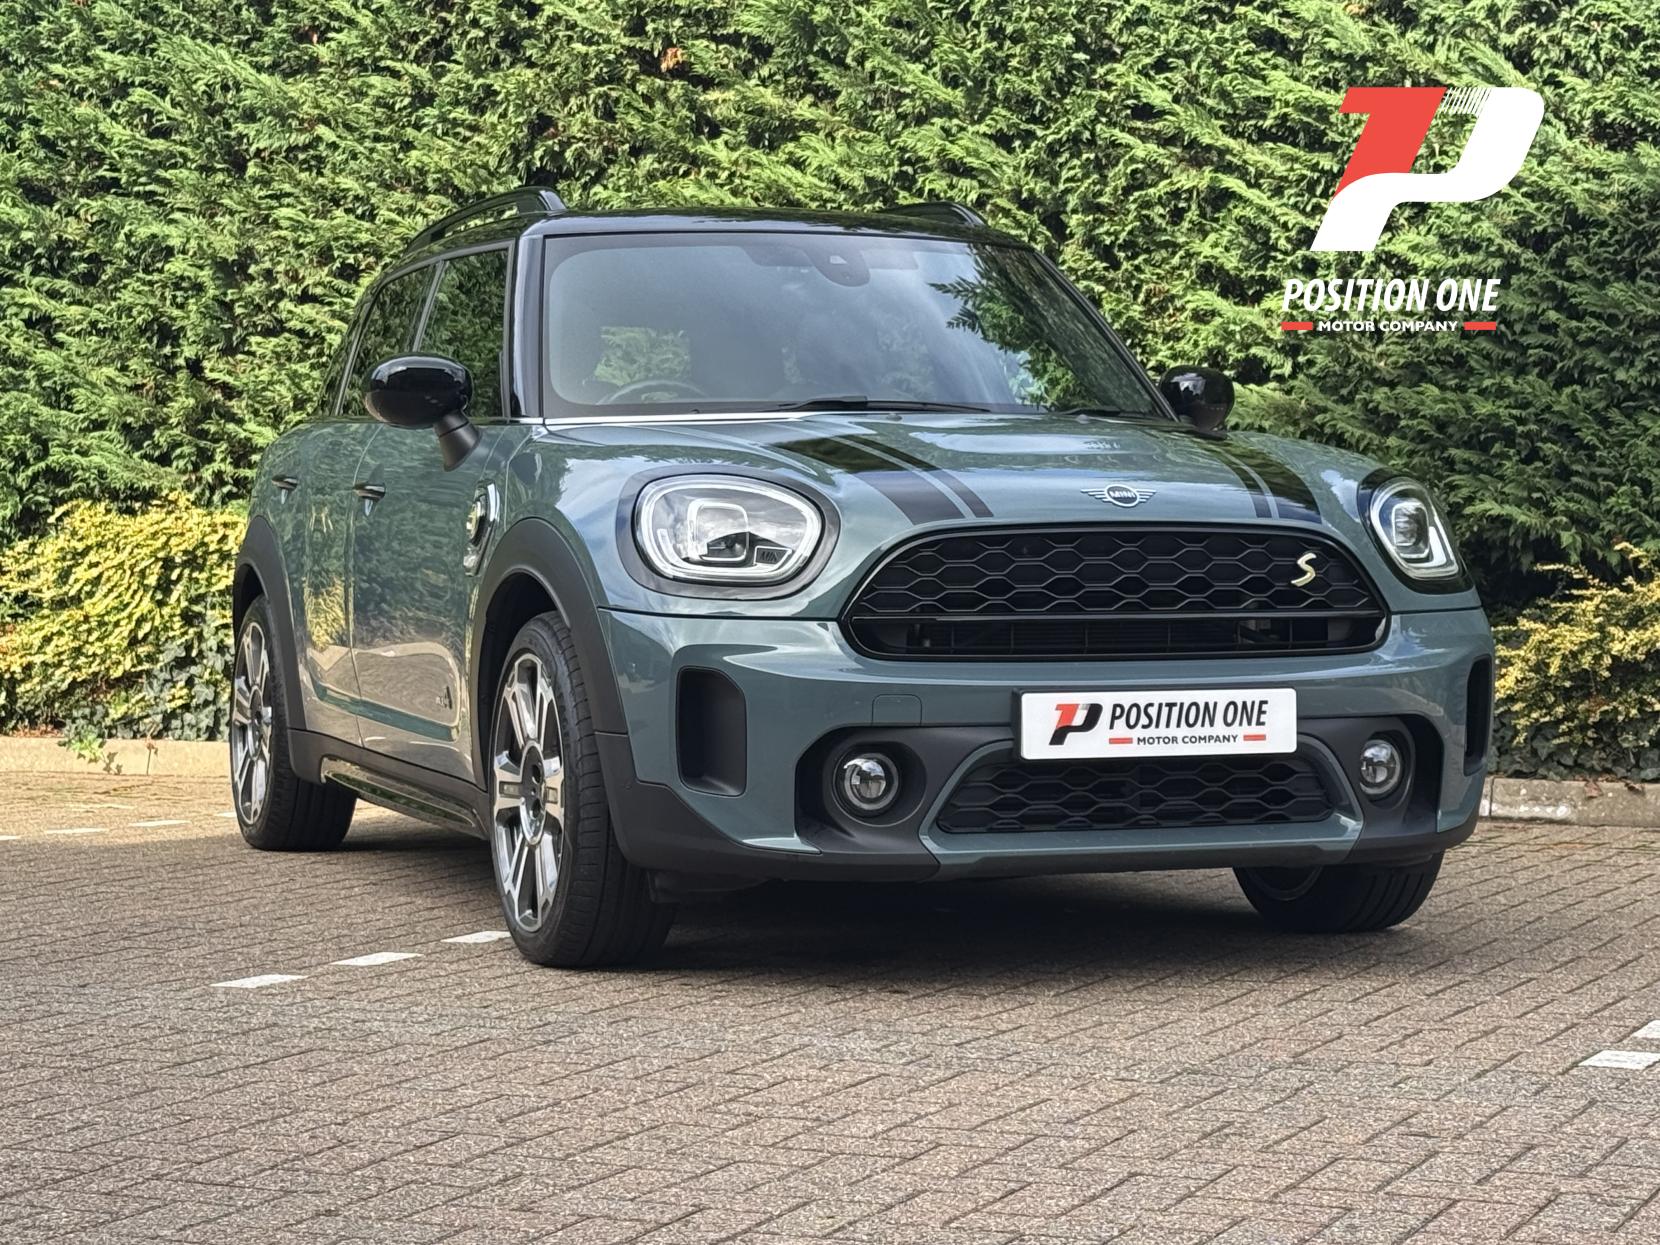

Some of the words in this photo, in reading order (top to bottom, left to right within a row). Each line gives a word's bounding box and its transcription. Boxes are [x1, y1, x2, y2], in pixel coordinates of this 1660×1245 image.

[1290, 552, 1317, 587] S
[1109, 701, 1218, 730] POSITION
[1222, 700, 1269, 728] ONE
[1136, 735, 1179, 746] MOTOR
[1181, 734, 1239, 745] COMPANY
